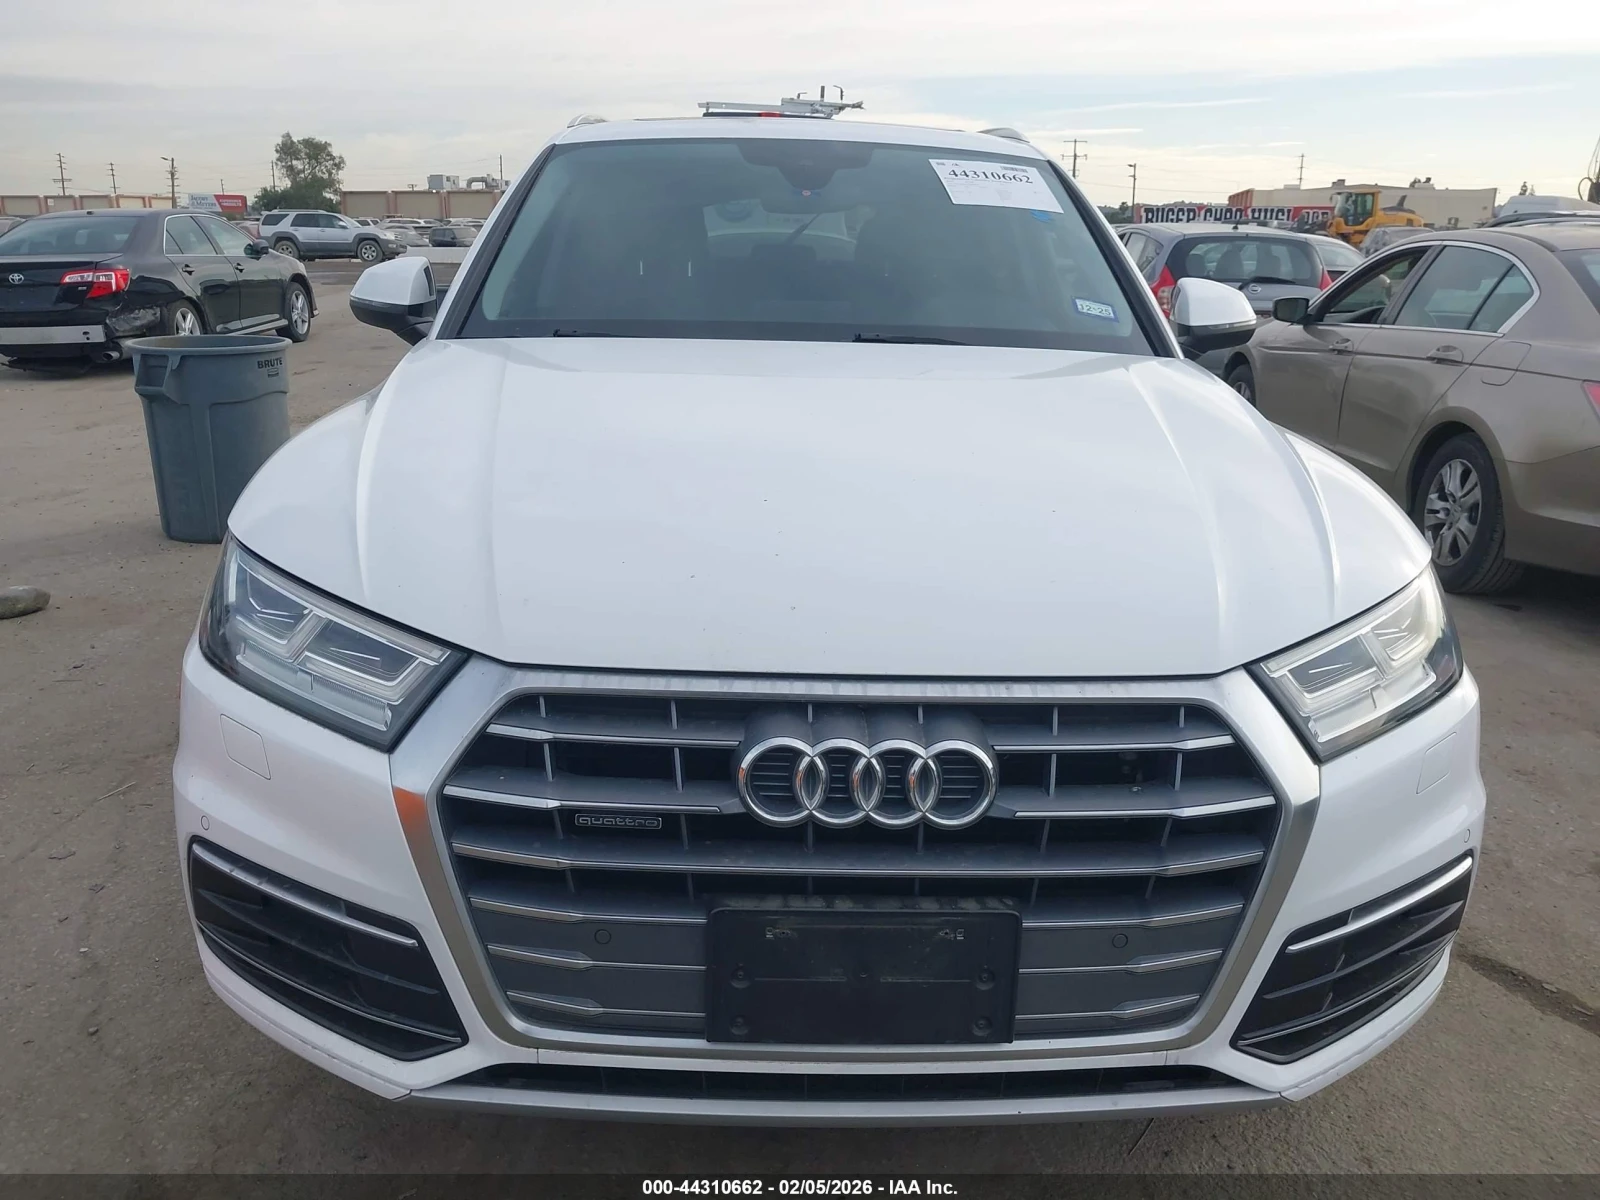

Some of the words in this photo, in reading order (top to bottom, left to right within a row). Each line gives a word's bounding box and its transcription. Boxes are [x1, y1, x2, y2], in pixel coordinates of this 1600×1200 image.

[948, 169, 1034, 184] 44310662
[257, 357, 283, 369] BRUTE
[579, 817, 659, 827] quattro
